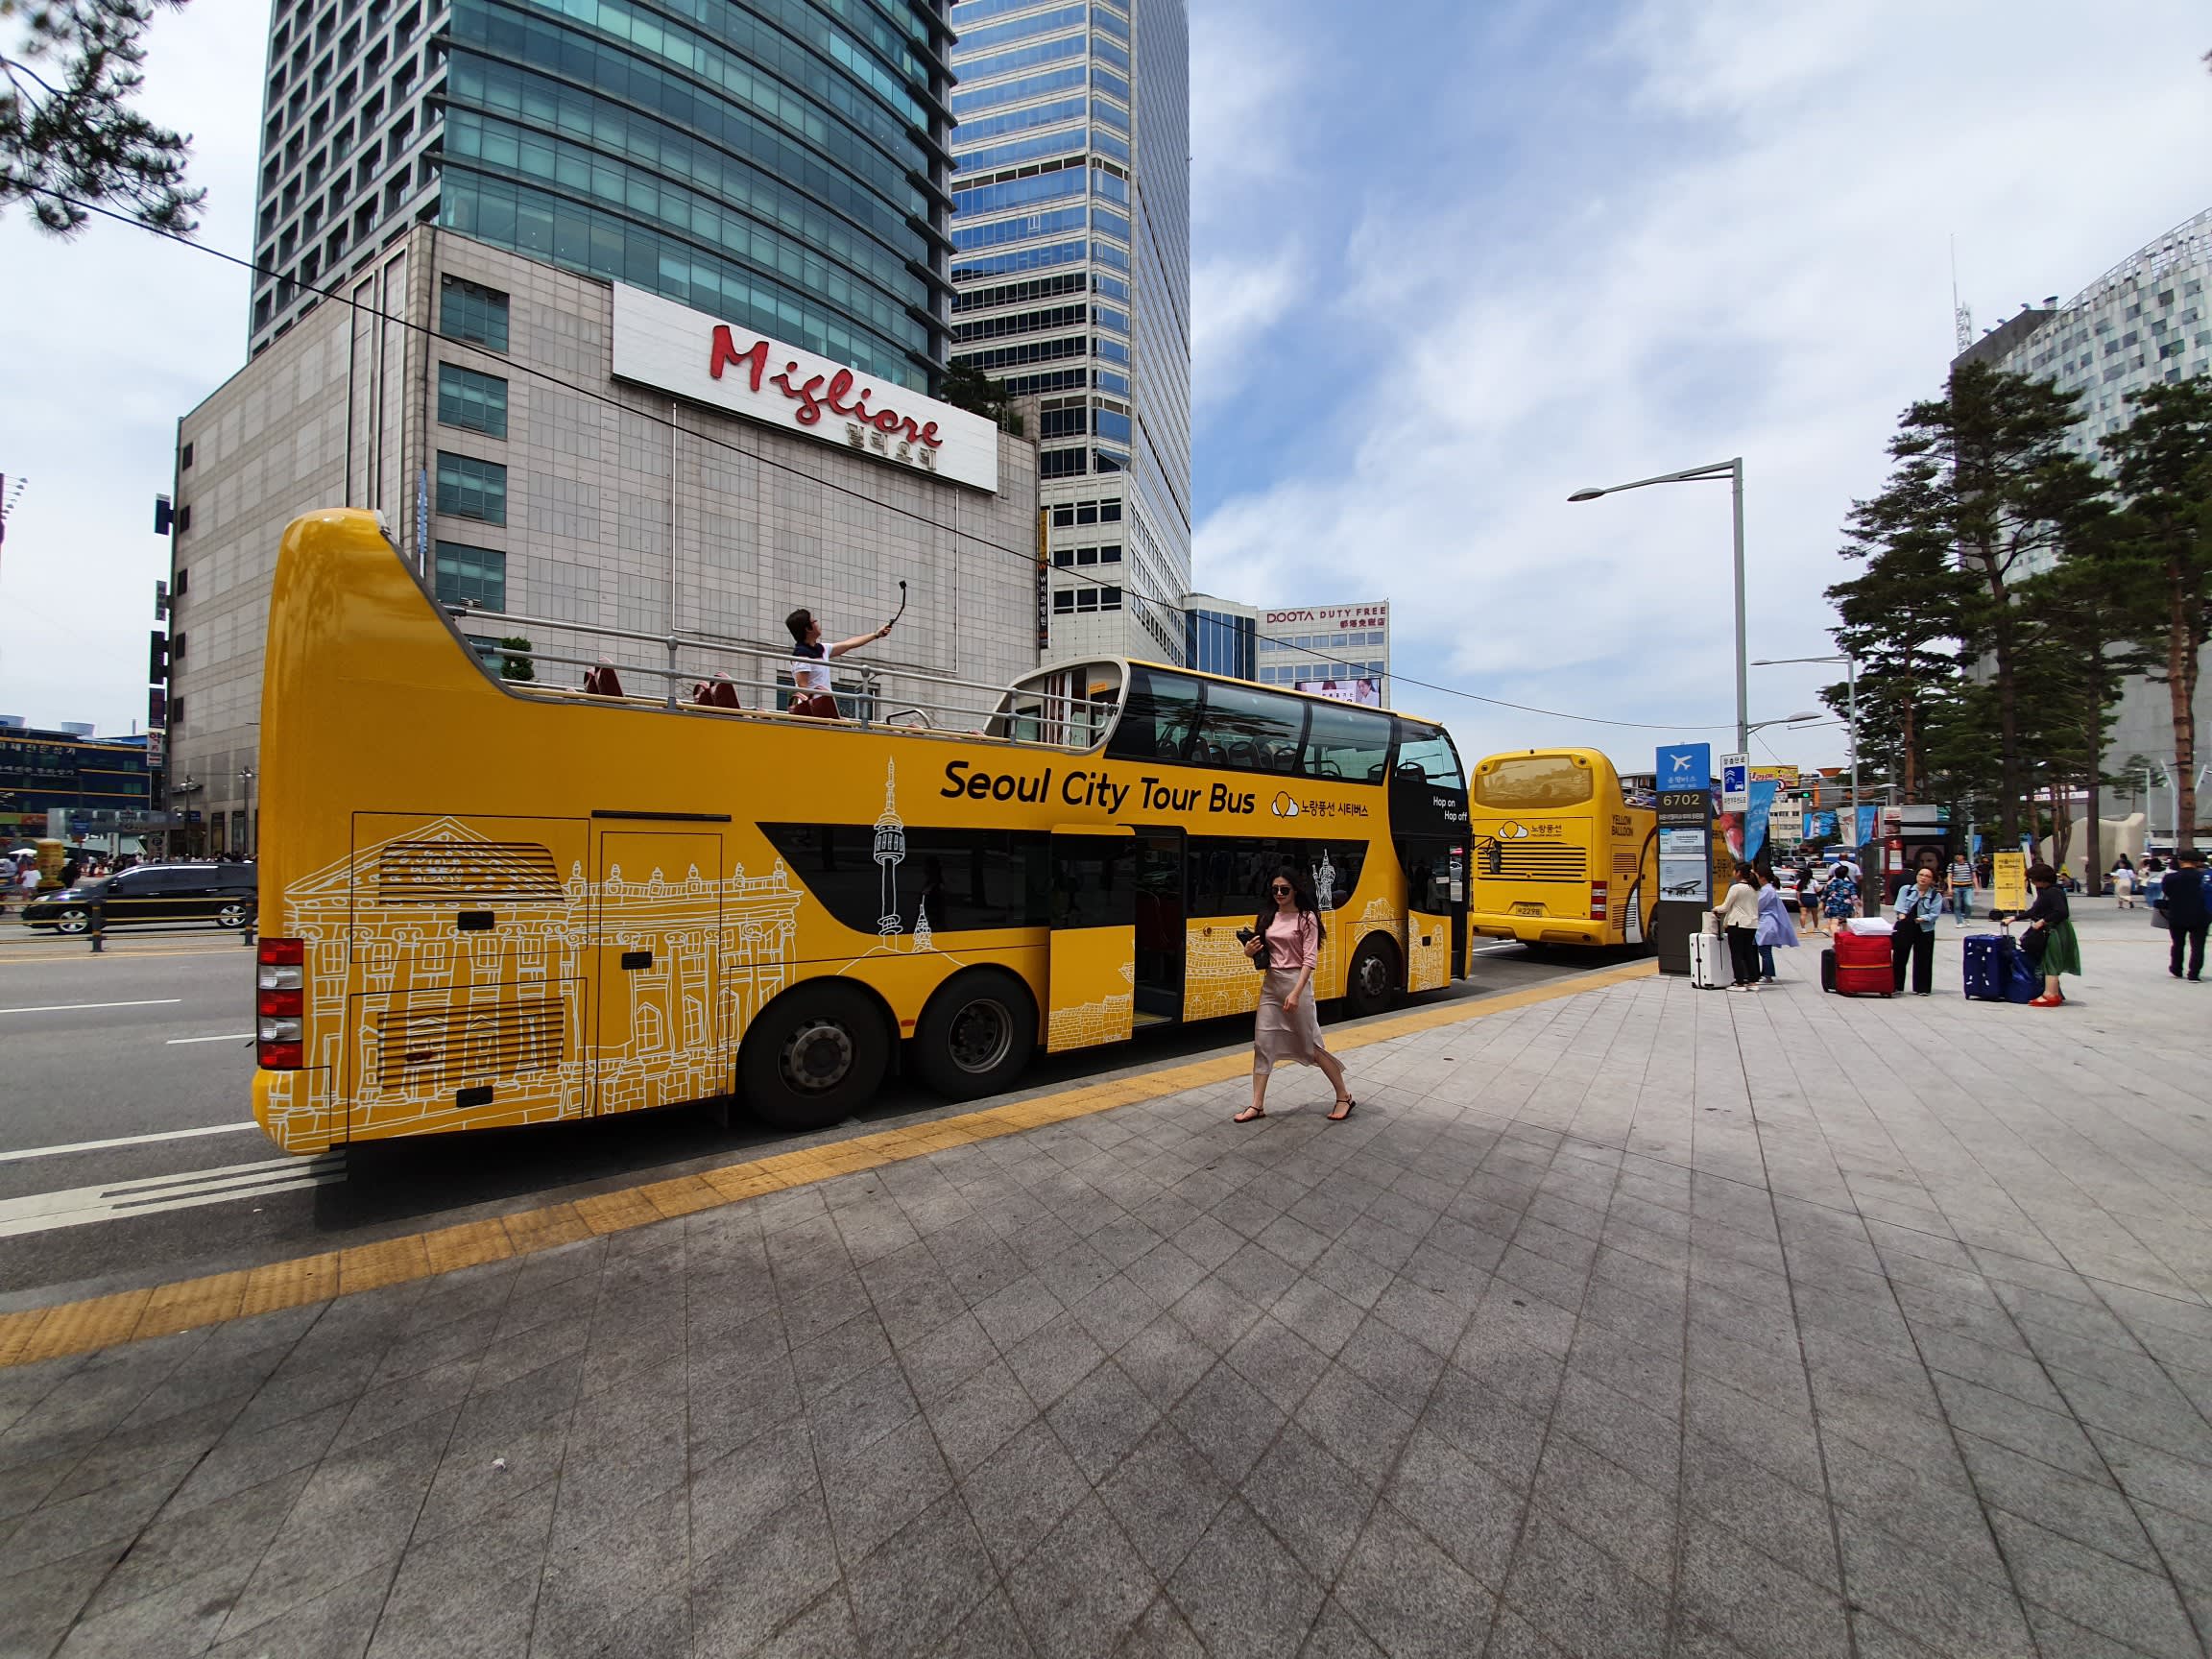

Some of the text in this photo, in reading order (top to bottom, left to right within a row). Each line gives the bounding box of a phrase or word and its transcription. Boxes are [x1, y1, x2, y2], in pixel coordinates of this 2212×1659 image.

[709, 325, 944, 447] Migliore
[846, 422, 937, 469] 밀리오레
[1320, 609, 1352, 619] DUTY
[1357, 606, 1386, 616] FREE
[941, 760, 1256, 814] Seoul City Tour Bus
[1432, 796, 1456, 808] Hop on
[1663, 793, 1700, 806] 6702
[1301, 799, 1369, 817] 노랑풍선 시티버스
[1444, 810, 1468, 823] Hop off
[1530, 824, 1562, 833] 노랑풍선
